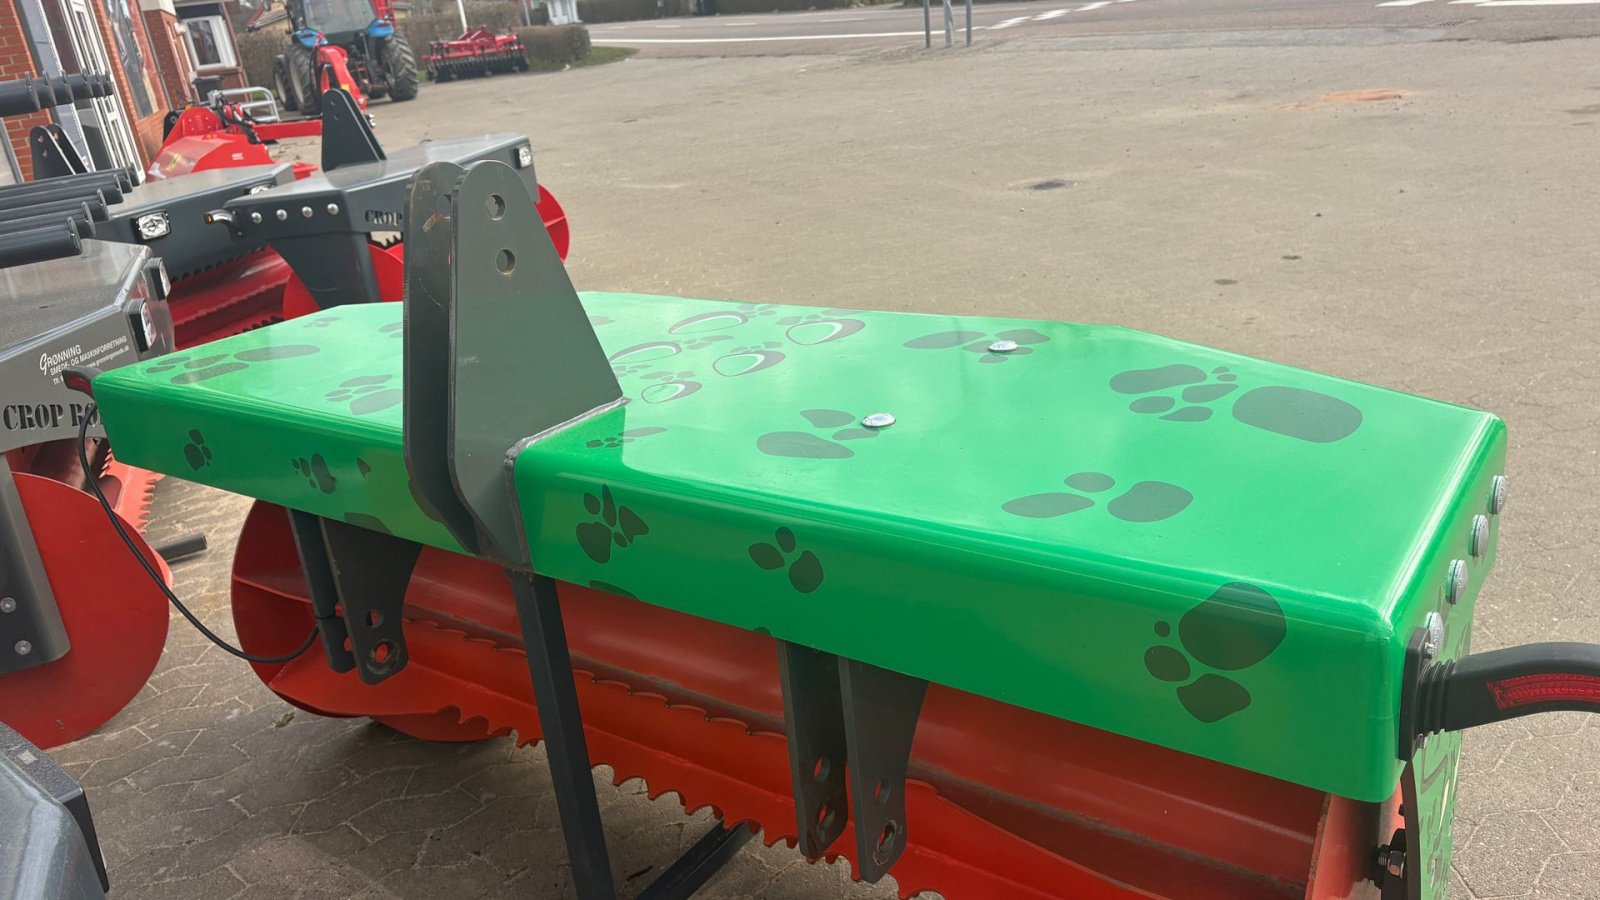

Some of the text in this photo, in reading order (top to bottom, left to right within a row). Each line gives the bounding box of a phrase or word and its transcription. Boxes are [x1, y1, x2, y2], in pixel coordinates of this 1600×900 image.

[365, 210, 402, 226] CROP
[40, 344, 81, 375] GRØNNING
[71, 357, 79, 366] OG
[3, 404, 64, 430] CROP
